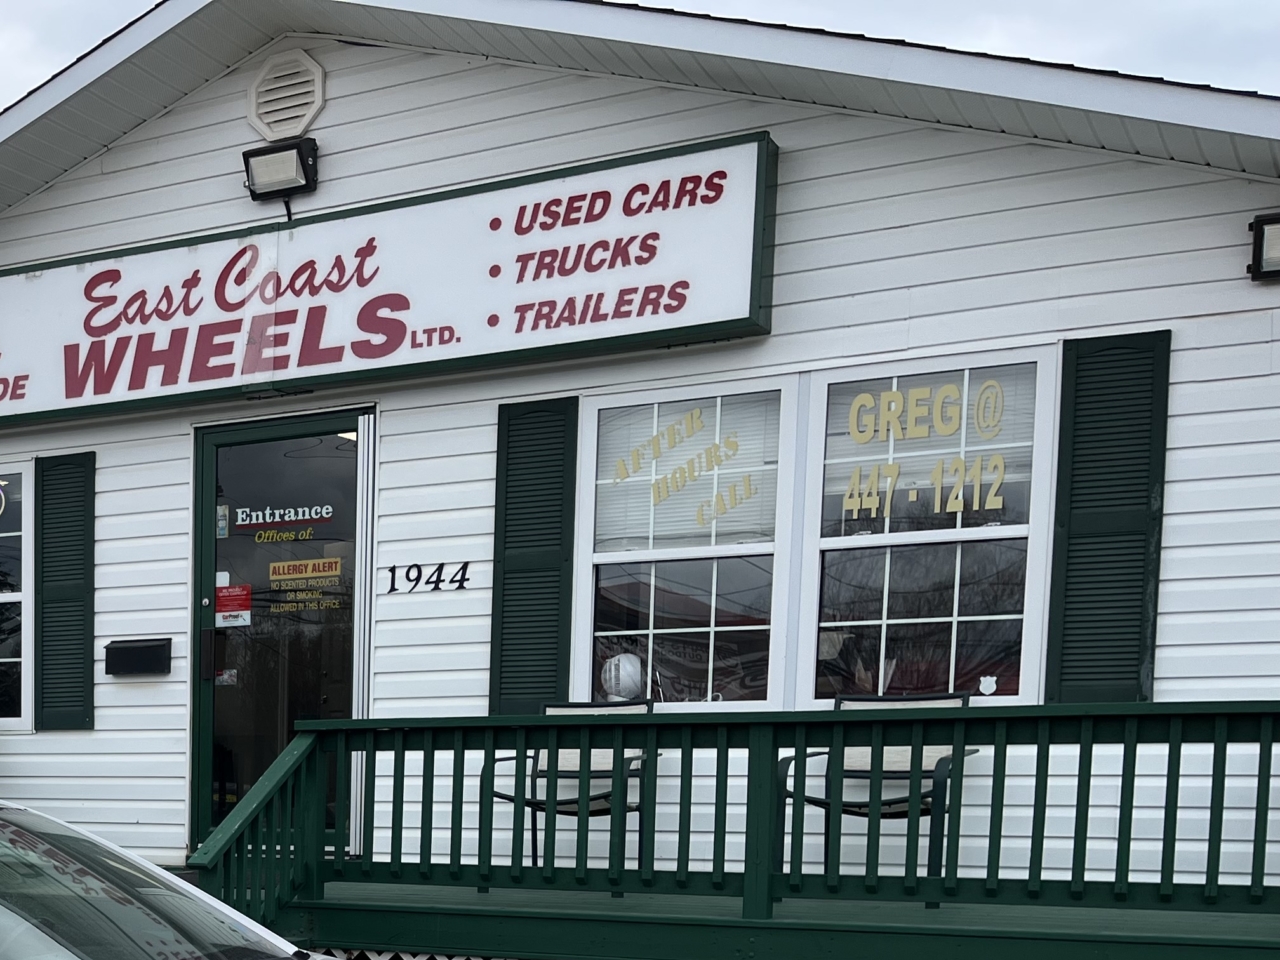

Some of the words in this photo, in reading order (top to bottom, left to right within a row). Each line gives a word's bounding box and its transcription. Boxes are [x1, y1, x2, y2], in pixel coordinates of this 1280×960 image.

[515, 191, 614, 237] USED
[622, 168, 729, 220] CARS
[514, 231, 661, 283] TRUCKS
[82, 269, 203, 338] East
[214, 239, 380, 307] Coast
[514, 279, 691, 335] TRAILERS
[62, 292, 412, 400] WHEELS
[410, 324, 462, 351] LTD.
[849, 384, 961, 444] GREG
[973, 380, 1004, 440] @
[612, 407, 705, 485] AFTER
[651, 430, 740, 506] HOURS
[695, 473, 758, 527] CALL
[843, 463, 900, 520] 447
[931, 454, 1005, 514] 1212
[235, 504, 333, 526] Entrance
[255, 529, 295, 543] Offices
[271, 563, 309, 577] ALLERGY
[311, 560, 339, 574] ALERT
[271, 581, 280, 590] NO
[280, 579, 307, 590] SCENTED
[308, 577, 339, 588] PRODUCTS
[286, 592, 295, 600] OR
[296, 590, 323, 600] SMOKING
[387, 561, 470, 594] 1944
[270, 602, 297, 613] ALLOWED
[298, 601, 304, 610] IN
[305, 601, 318, 610] THIS
[319, 599, 340, 610] OFFICE
